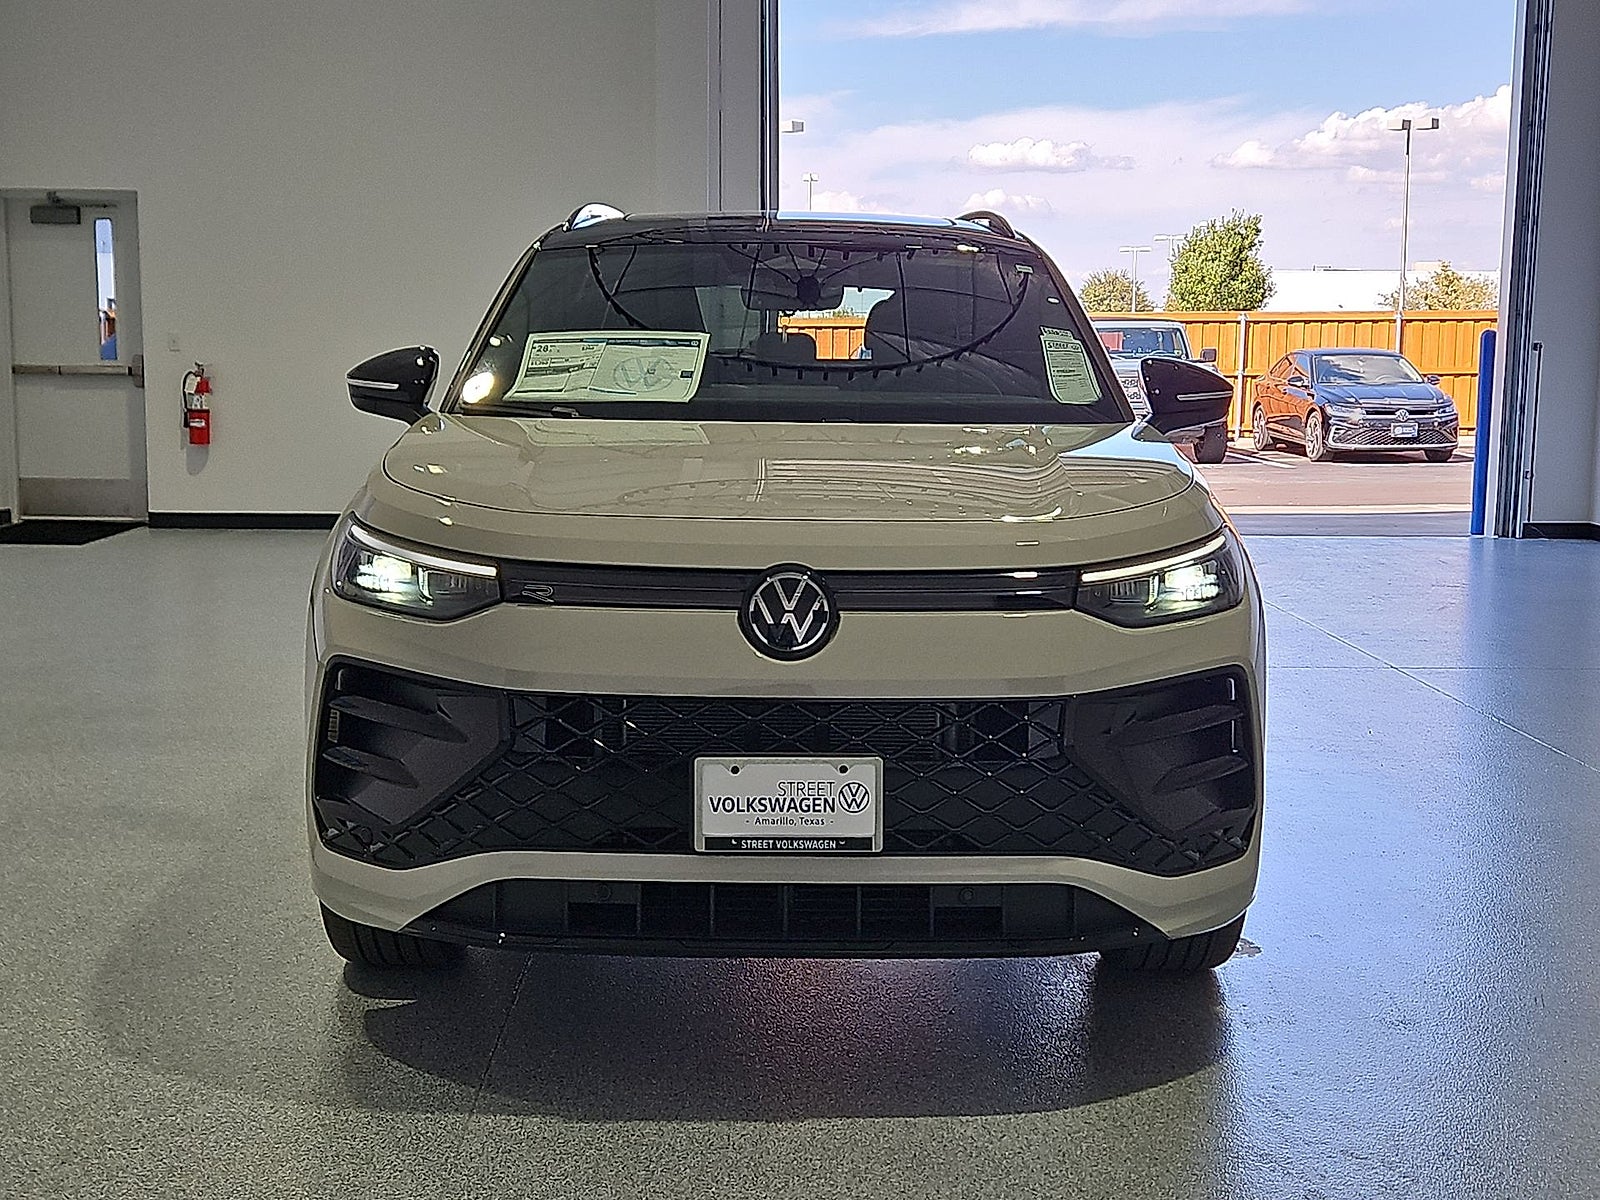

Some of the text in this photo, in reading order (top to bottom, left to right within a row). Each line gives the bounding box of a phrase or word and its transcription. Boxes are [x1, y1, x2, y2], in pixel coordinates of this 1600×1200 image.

[777, 781, 835, 796] STREET
[709, 796, 836, 813] VOLKSWAGEN
[754, 816, 825, 827] Amarillo, Texas
[741, 840, 837, 849] STREET VOLKSWAGEN
